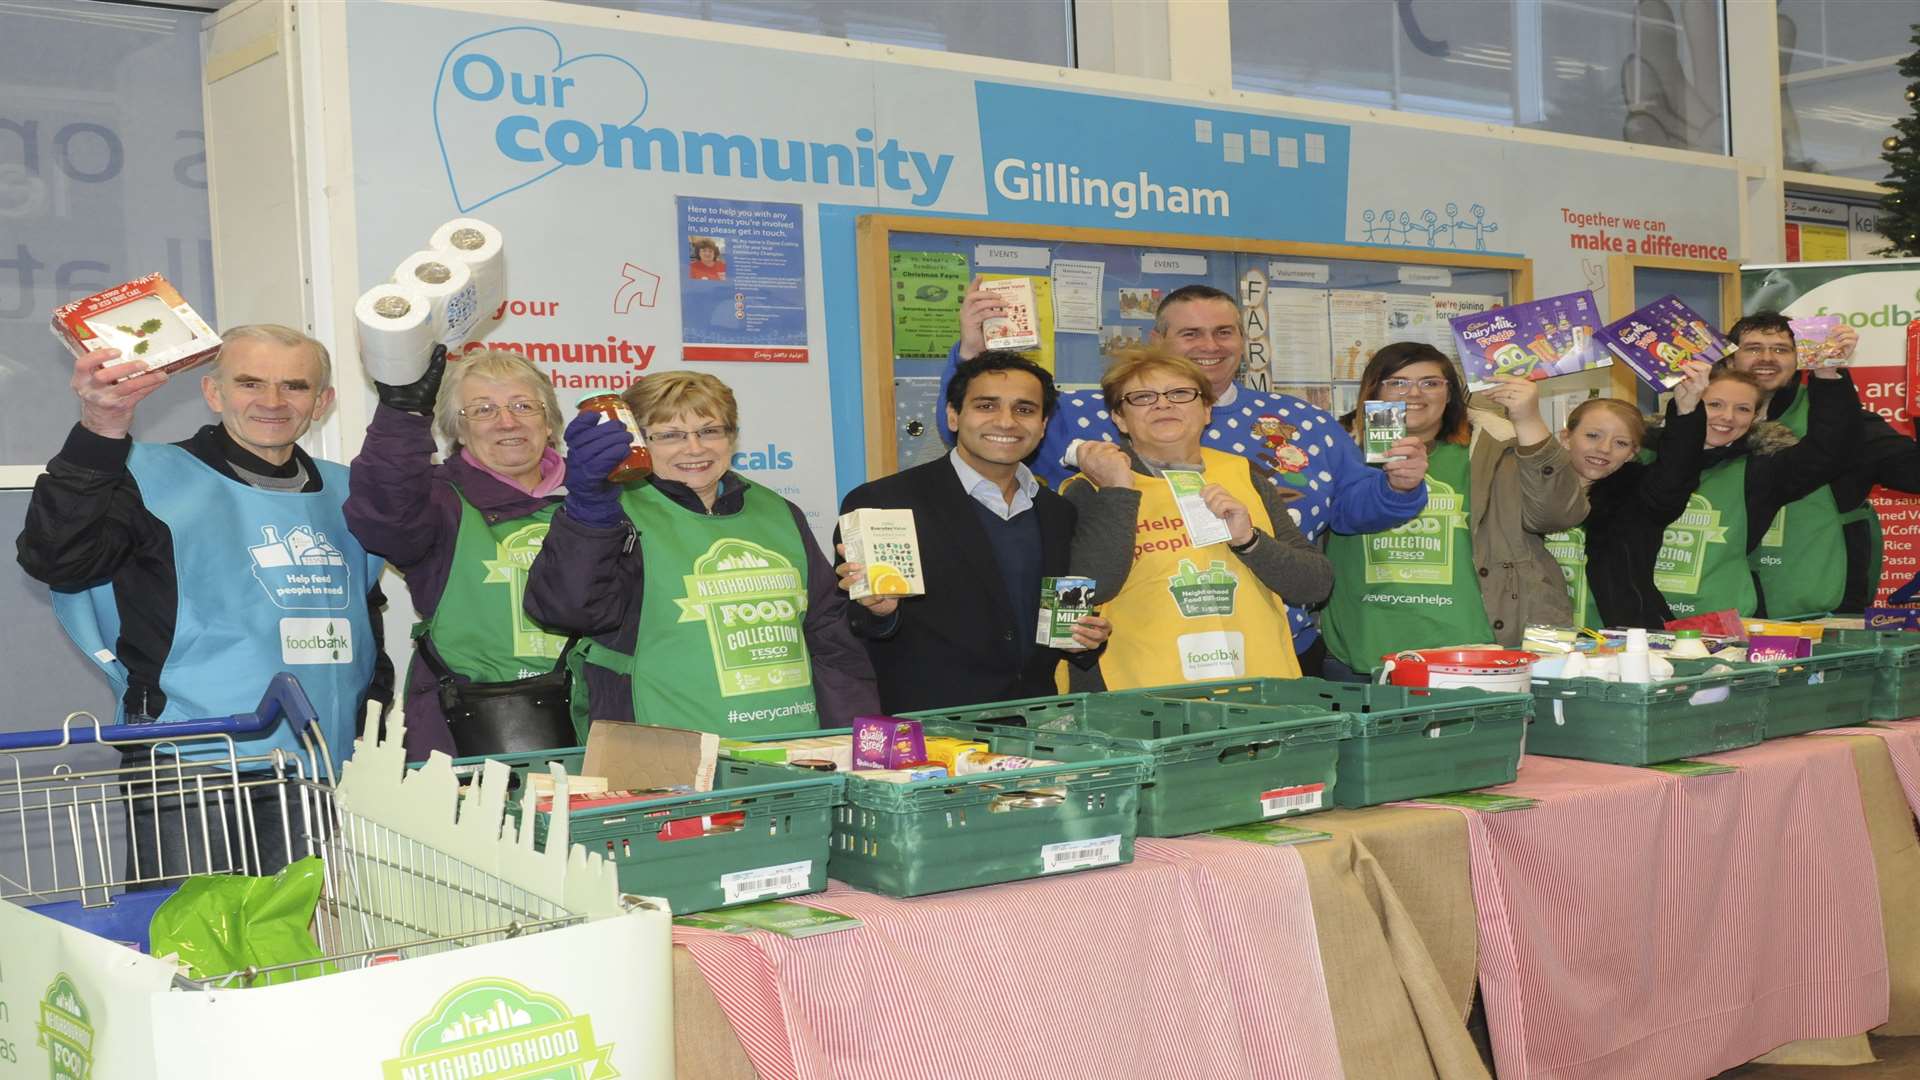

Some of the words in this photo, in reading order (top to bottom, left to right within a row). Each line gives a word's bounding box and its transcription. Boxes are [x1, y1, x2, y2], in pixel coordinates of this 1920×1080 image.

[452, 53, 574, 107] Our
[495, 115, 955, 206] community
[993, 158, 1230, 218] Gillingham
[687, 205, 707, 214] Here
[719, 207, 736, 217] help
[753, 210, 771, 219] with
[773, 212, 787, 221] any
[1561, 208, 1620, 228] Together
[1622, 218, 1641, 230] we
[1643, 220, 1666, 232] can
[687, 215, 707, 223] local
[735, 218, 760, 227] you're
[762, 219, 794, 229] involved
[687, 224, 698, 232] in,
[710, 227, 737, 236] please
[738, 228, 752, 237] get
[752, 227, 760, 235] in
[762, 228, 786, 238] touch.
[1570, 230, 1622, 252] make
[1626, 239, 1637, 253] a
[1641, 234, 1728, 260] difference
[989, 249, 1018, 258] EVENTS
[1153, 260, 1180, 269] EVENTS
[492, 300, 559, 320] your
[1458, 302, 1485, 312] joining
[1463, 327, 1490, 339] Dairy
[1490, 319, 1516, 331] Milk
[551, 370, 643, 390] hampi
[1369, 431, 1402, 440] MILK
[731, 444, 793, 470] cals
[1895, 497, 1920, 505] sau
[1908, 510, 1920, 520] V
[1136, 516, 1184, 534] Help
[1134, 534, 1191, 560] peopl
[1373, 536, 1440, 551] COLLECTION
[1884, 541, 1912, 550] Rice
[286, 575, 309, 584] Help
[697, 573, 798, 597] NEIGHBOURHOOD
[276, 587, 311, 597] people
[312, 585, 321, 594] in
[719, 600, 795, 627] FOOD
[286, 635, 348, 649] foodbank
[728, 625, 798, 650] COLLECTION
[750, 645, 788, 660] TESCO
[727, 702, 816, 723] #everycanhelps
[860, 728, 887, 743] Quality
[861, 741, 884, 753] Street
[401, 1028, 580, 1080] NEIGHBOURHOOD
